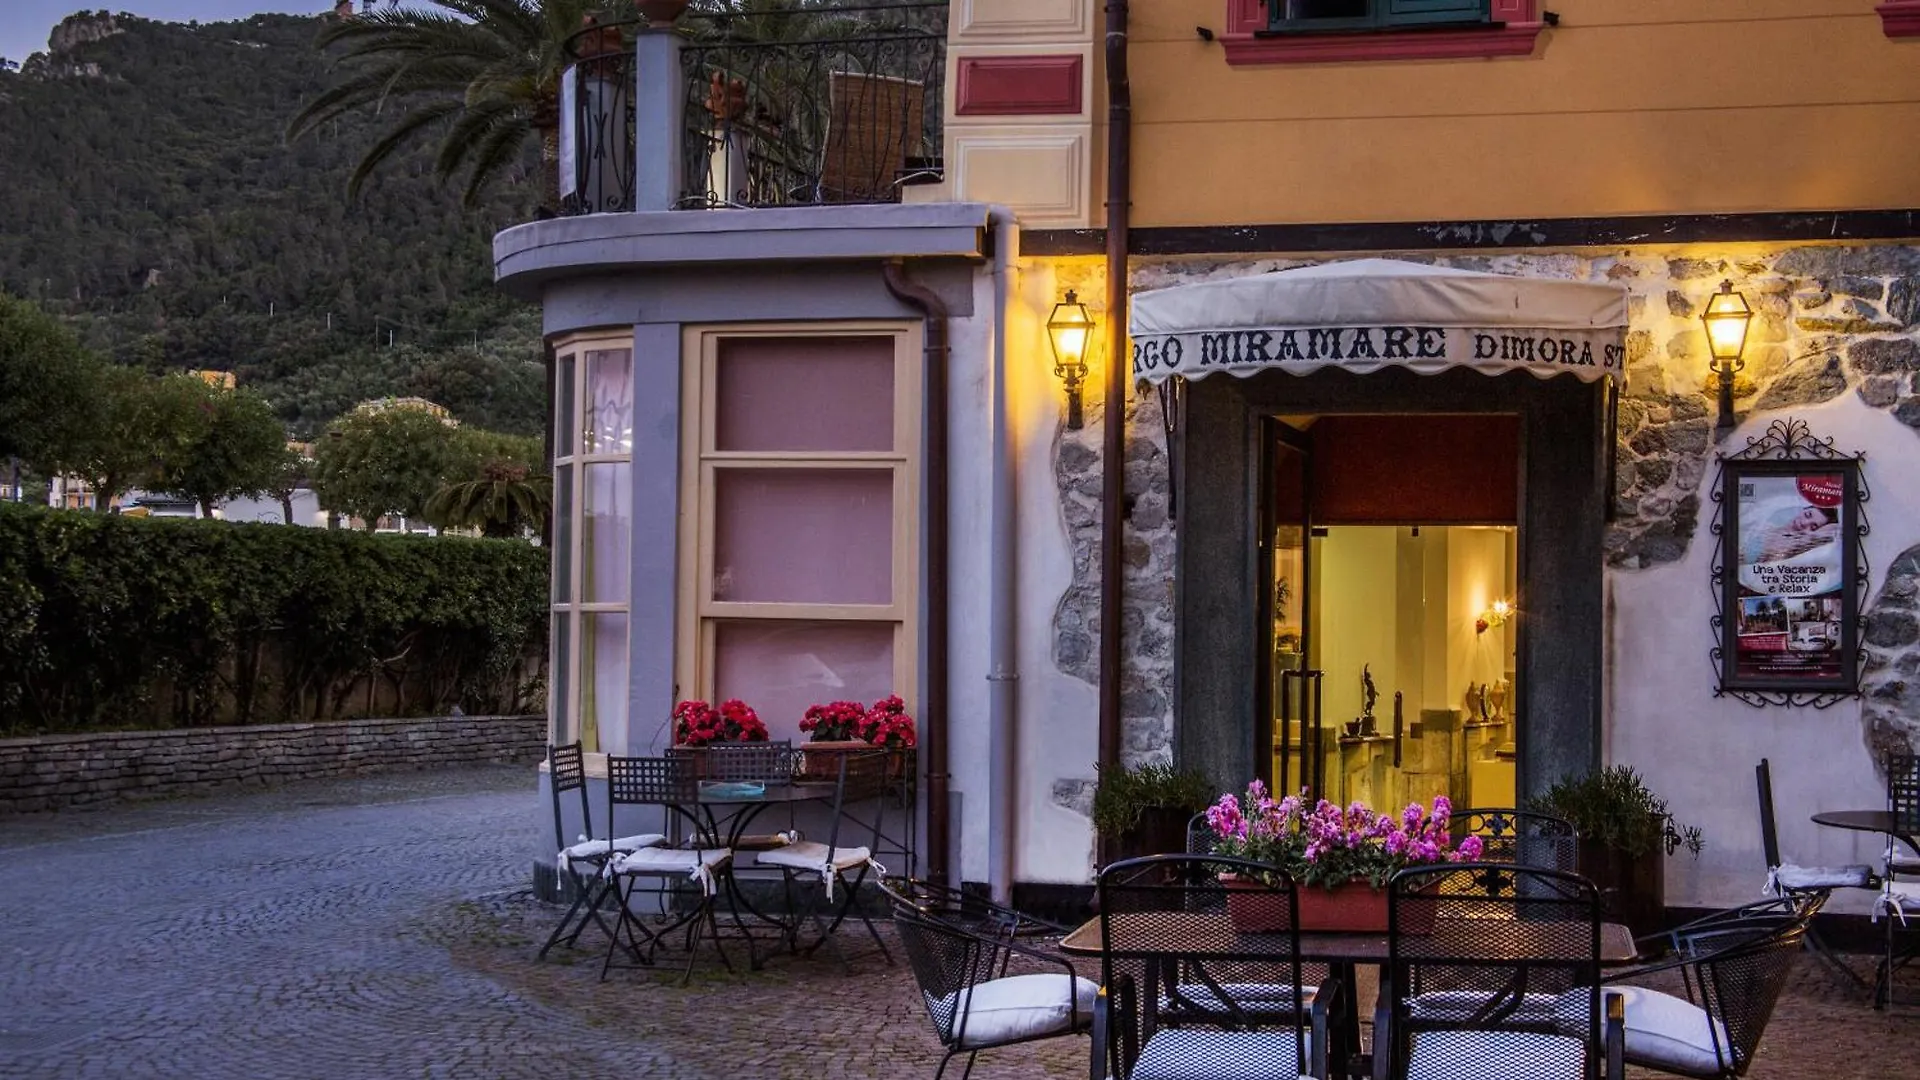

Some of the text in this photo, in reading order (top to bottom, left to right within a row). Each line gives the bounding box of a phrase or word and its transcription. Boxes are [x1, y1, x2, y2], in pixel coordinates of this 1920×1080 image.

[1132, 327, 1626, 373] RGO MIRAMARE DIMORA ST
[1753, 565, 1826, 574] Una Vacanza
[1761, 574, 1818, 584] tra Storia
[1768, 584, 1810, 593] e Relax
